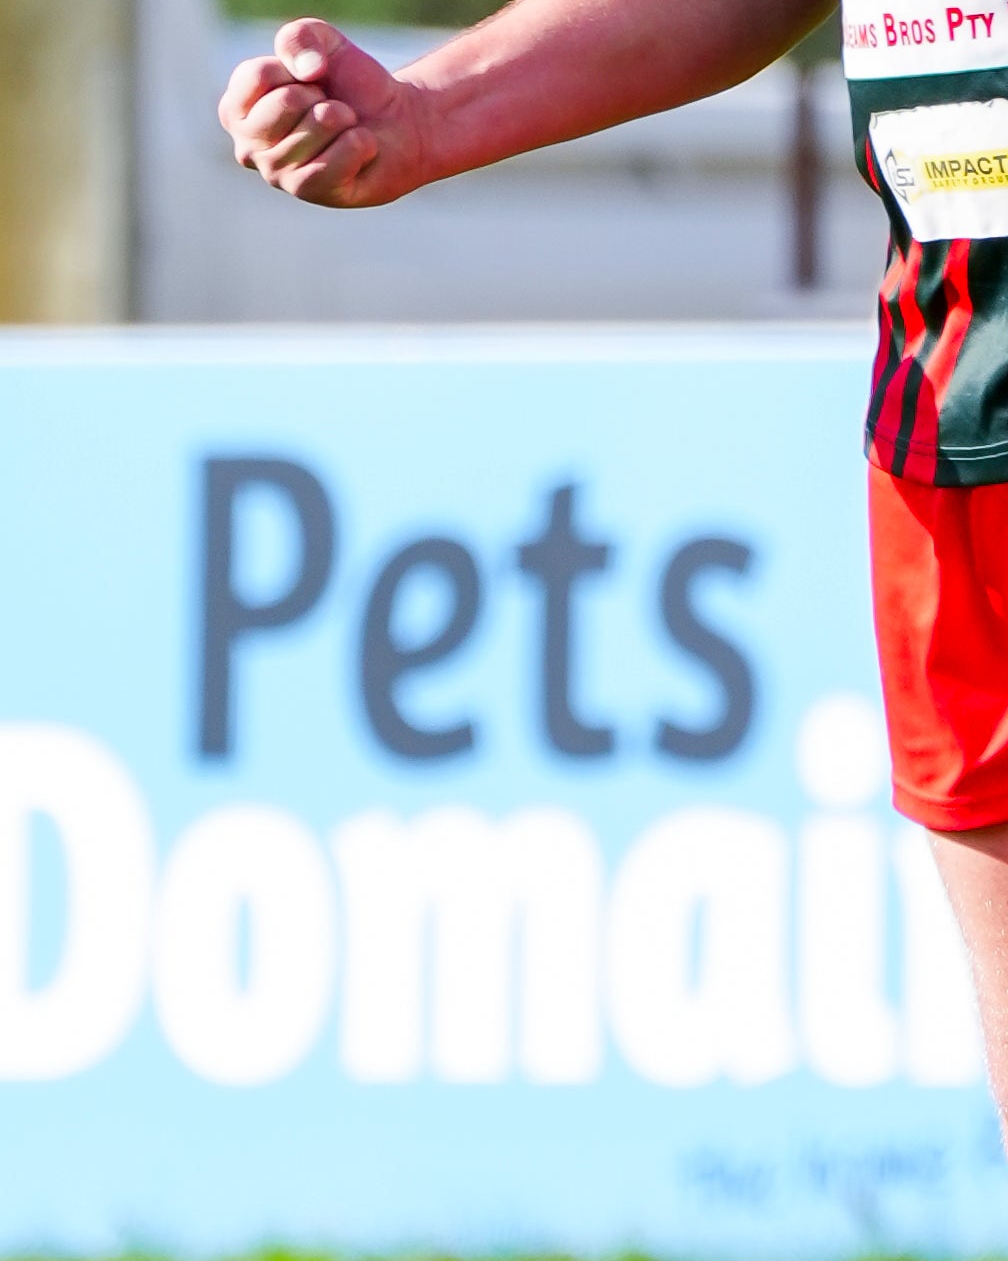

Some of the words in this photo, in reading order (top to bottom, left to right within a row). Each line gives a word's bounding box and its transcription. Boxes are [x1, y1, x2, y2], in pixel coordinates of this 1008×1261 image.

[845, 23, 878, 48] EAMS
[924, 154, 1008, 180] IMPACT
[194, 453, 760, 763] Pets
